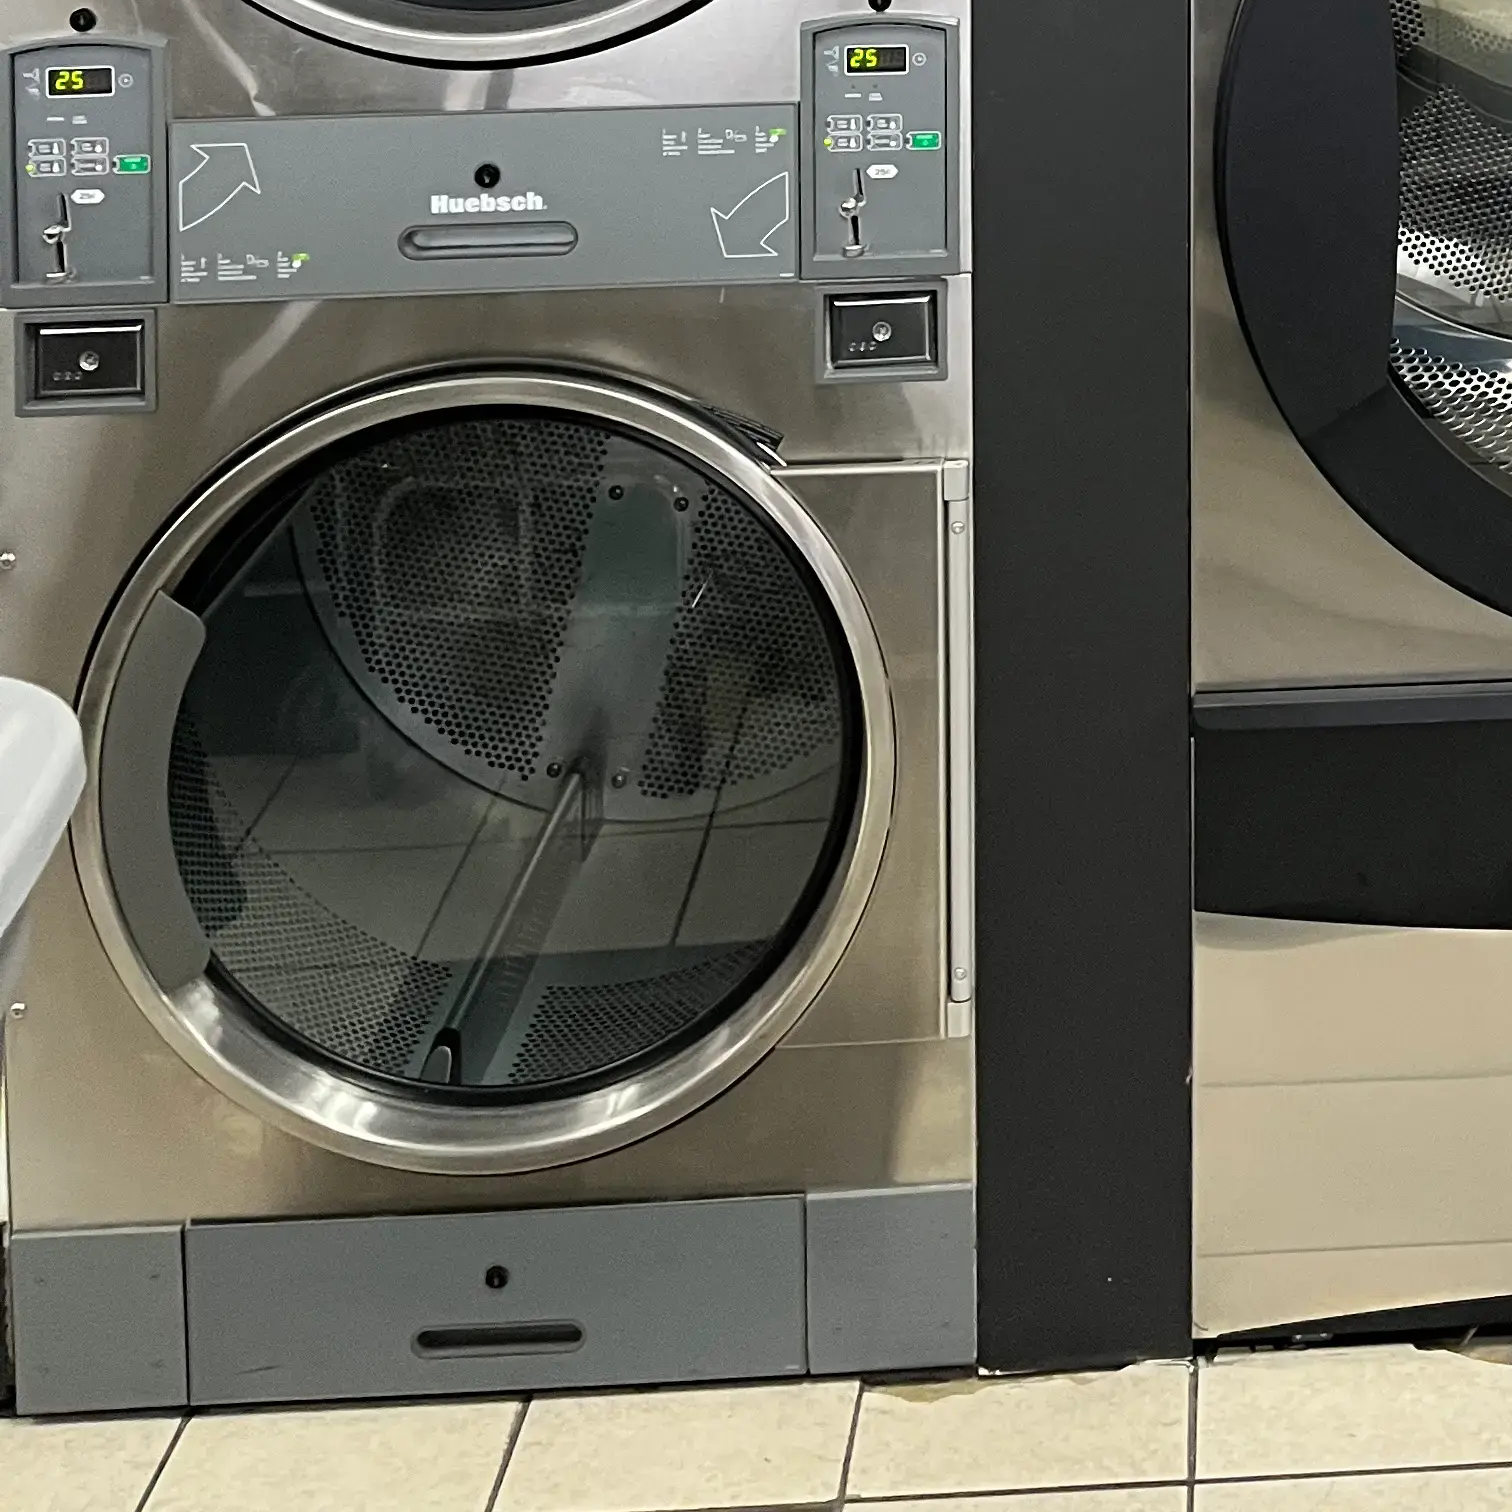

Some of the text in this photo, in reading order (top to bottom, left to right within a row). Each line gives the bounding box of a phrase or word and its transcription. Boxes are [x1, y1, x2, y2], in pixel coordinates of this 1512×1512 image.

[850, 48, 878, 68] 25
[55, 70, 84, 90] 25
[430, 191, 545, 214] Huebsch
